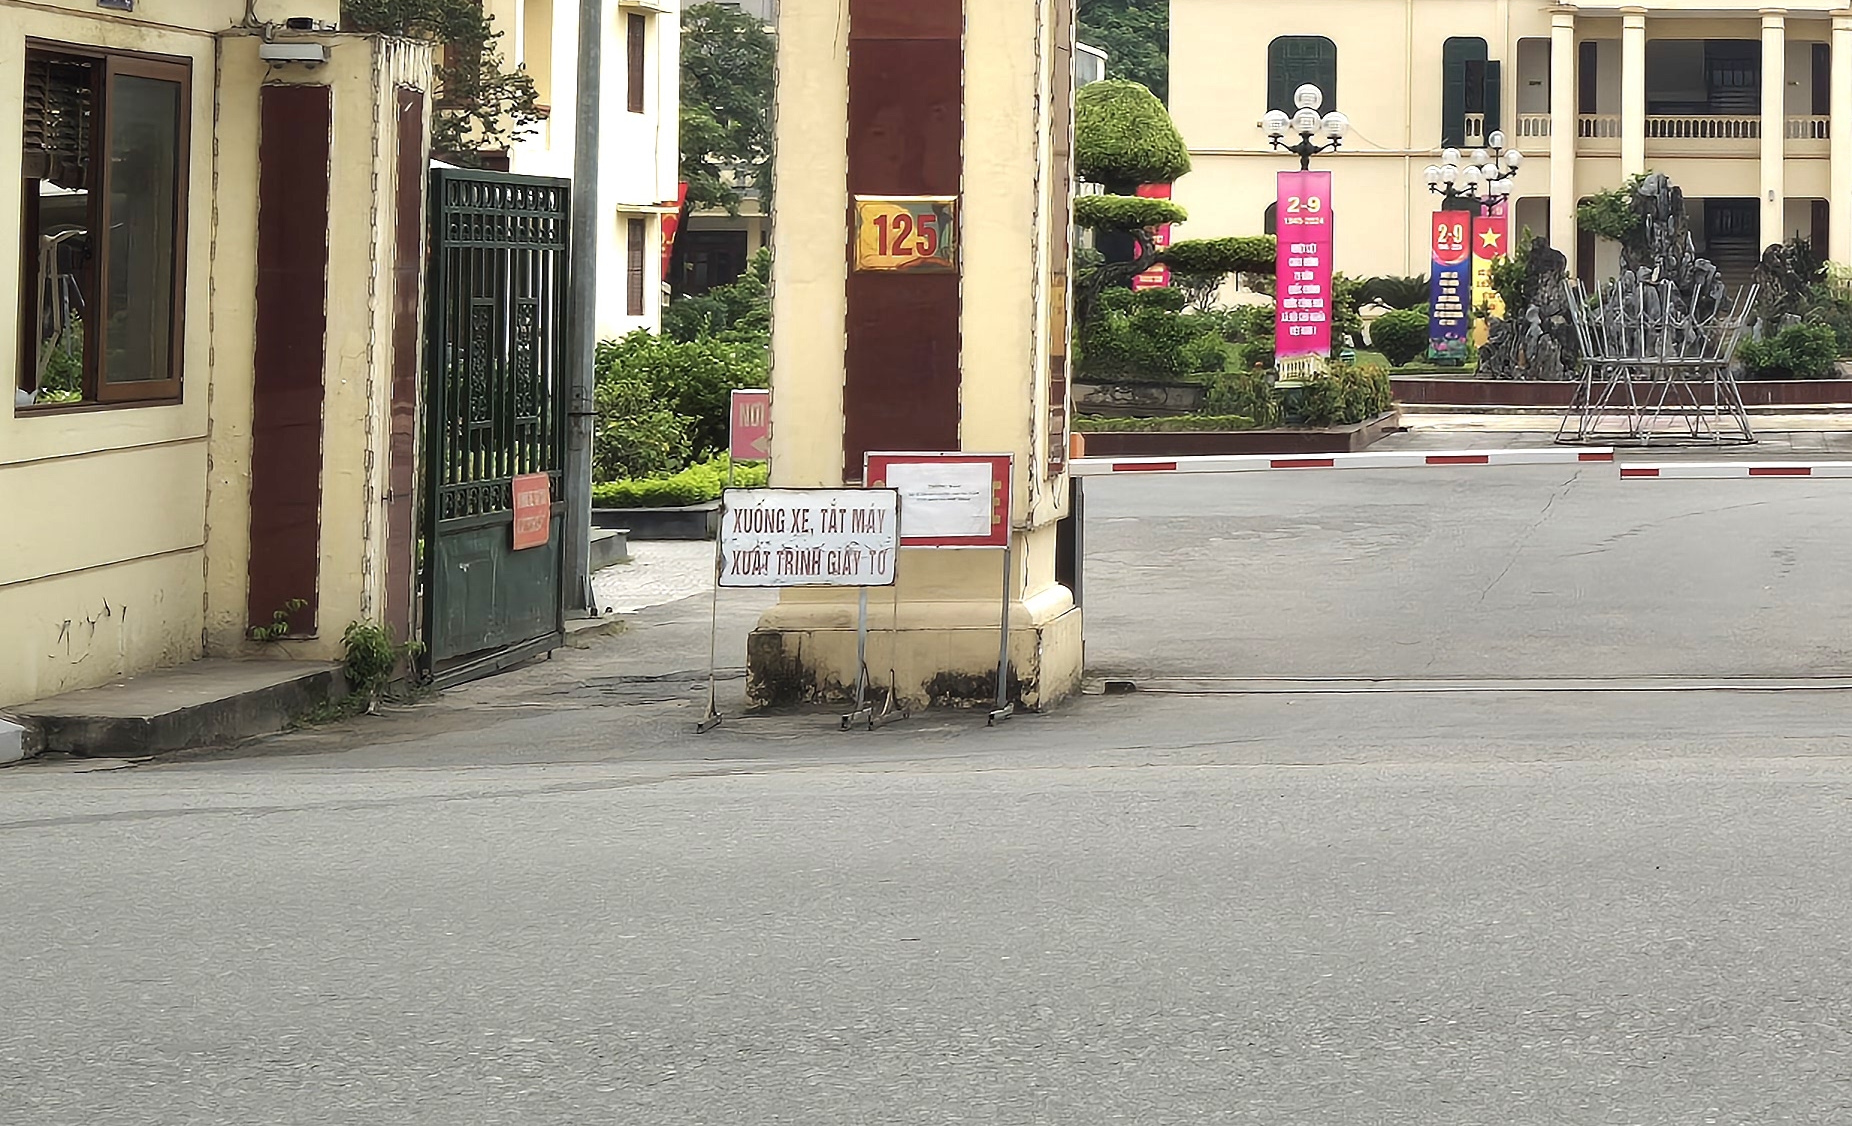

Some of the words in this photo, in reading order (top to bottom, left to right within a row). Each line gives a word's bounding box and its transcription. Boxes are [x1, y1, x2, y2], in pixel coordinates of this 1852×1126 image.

[1286, 196, 1321, 214] 2-9
[873, 213, 938, 257] 125
[1437, 223, 1463, 244] 2-9
[732, 498, 786, 534] XUỐNG
[851, 503, 887, 534] MÁY
